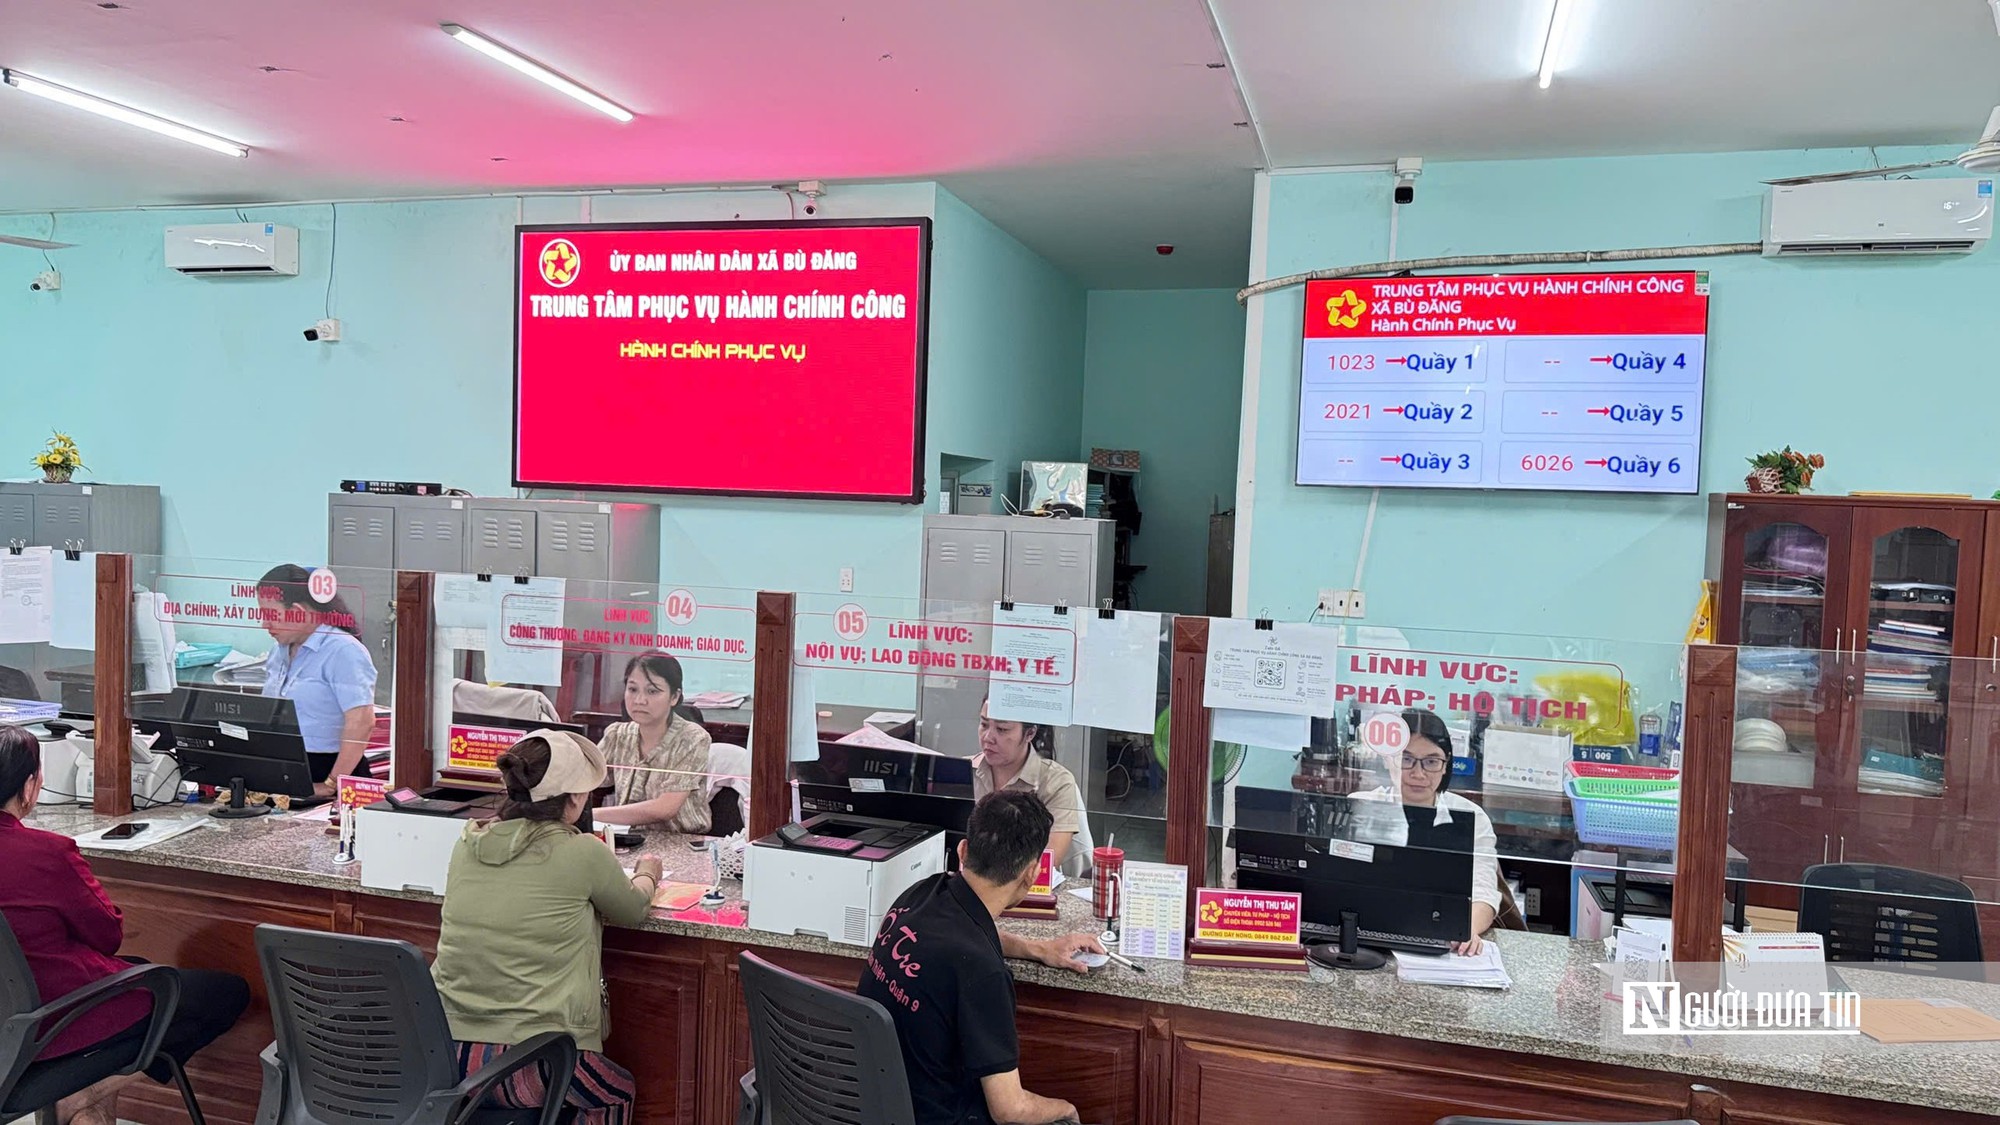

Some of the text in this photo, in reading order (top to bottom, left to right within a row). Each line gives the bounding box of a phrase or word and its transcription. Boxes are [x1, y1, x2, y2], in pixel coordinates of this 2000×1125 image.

[610, 249, 857, 272] ỦY BAN NHÂN DÂN XÃ BÙ ĐĂNG
[1372, 276, 1684, 299] TRUNG TÂM PHỤC VỤ HÀNH CHÍNH CÔNG
[531, 289, 905, 323] TRUNG TÂM PHỤC VỤ HÀNH CHÍNH CÔNG
[1371, 298, 1461, 314] XÃ BÙ ĐĂNG
[1371, 317, 1516, 334] Hành Chính Phục Vụ
[620, 340, 806, 362] HÀNH CHÍNH PHỤC VỤ
[1328, 351, 1473, 374] 1023 Quầy 1
[1612, 351, 1665, 373] Quầy
[1673, 354, 1686, 370] 4
[1324, 402, 1473, 424] 2021 Quầy 2
[1609, 403, 1663, 425] Quầy
[1671, 405, 1683, 422] 5
[1401, 451, 1451, 474] Quầy
[1458, 454, 1470, 470] 3
[1521, 453, 1680, 477] 6026 Quầy 6
[231, 582, 255, 598] LĨNH
[312, 575, 333, 595] 03
[164, 602, 181, 616] ĐỊA
[185, 602, 220, 619] CHÍNH;
[224, 605, 244, 618] XÂY
[248, 607, 281, 624] DỰNG;
[668, 595, 692, 619] 04
[838, 611, 863, 633] 05
[889, 621, 972, 644] LĨNH VỰC:
[510, 622, 536, 639] CÔNG
[614, 629, 625, 644] KÝ
[629, 633, 653, 646] KINH
[656, 635, 693, 651] DOANH;
[697, 635, 720, 652] GIÁO
[724, 638, 747, 655] DỤC.
[806, 642, 1059, 676] NỘI VỤ; LAO ĐỘNG TBXH; Y TẾ.
[1351, 653, 1518, 684] LĨNH VỰC:
[1335, 684, 1435, 709] PHÁP;
[1508, 697, 1586, 720] TỊCH
[1369, 720, 1401, 746] 06
[1581, 751, 1611, 760] 500 5
[864, 760, 898, 775] MSI
[1224, 896, 1295, 911] NGUYỄN THỊ THU TÂM
[892, 926, 921, 977] Tre
[889, 980, 910, 1006] Quận
[911, 1000, 919, 1012] 9
